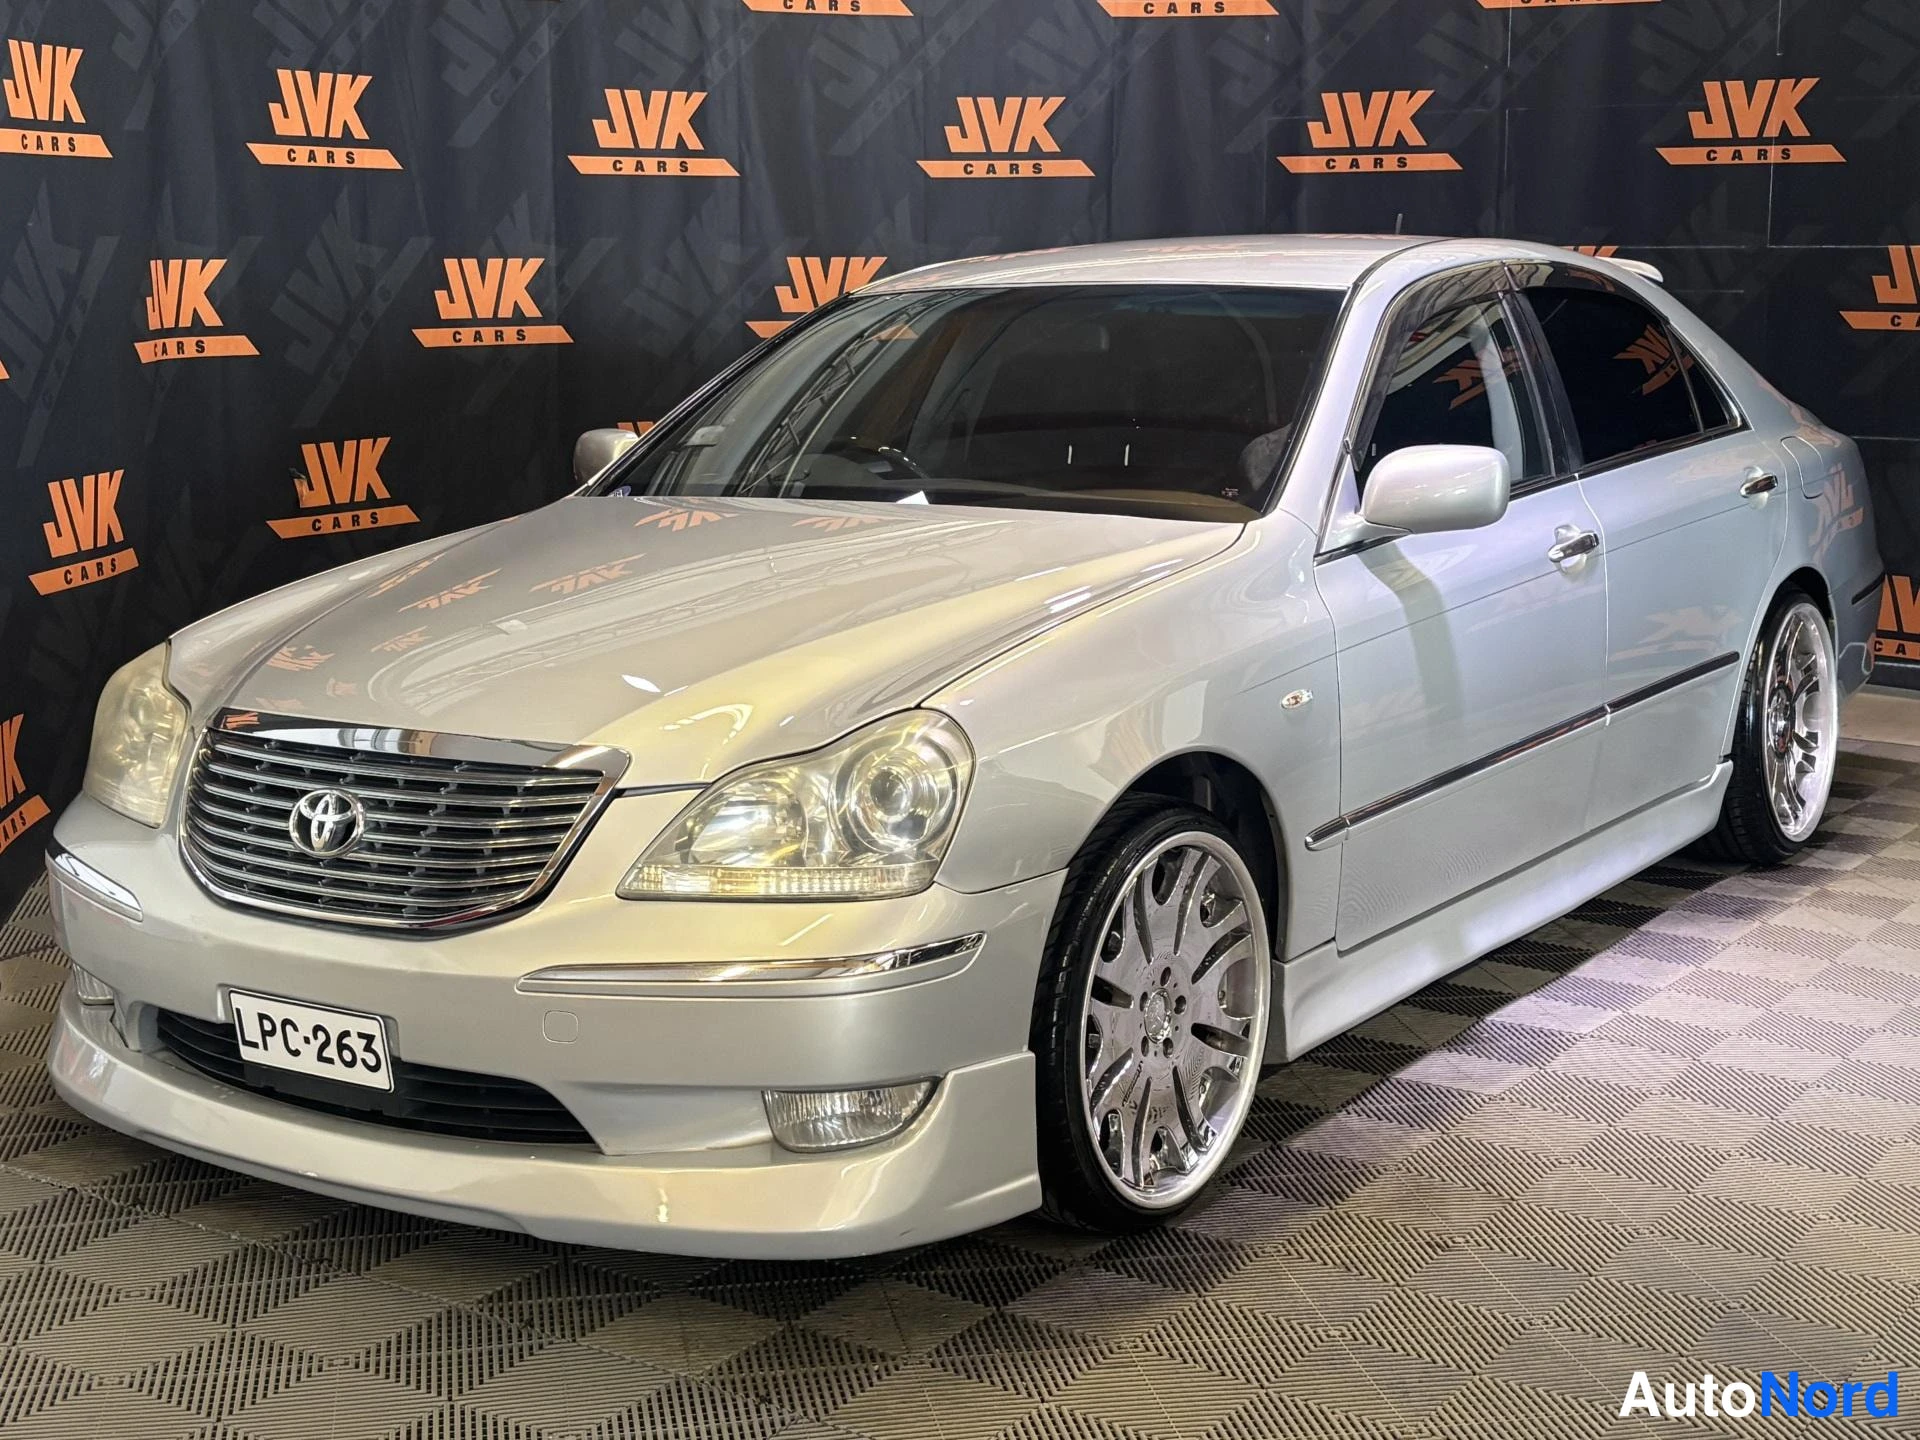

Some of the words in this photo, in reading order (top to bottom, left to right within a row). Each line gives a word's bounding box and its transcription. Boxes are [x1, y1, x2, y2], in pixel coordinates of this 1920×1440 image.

[783, 0, 861, 12] CARS
[1143, 1, 1226, 15] CARS
[3, 39, 86, 124] JVK
[268, 68, 373, 140] JVK
[592, 88, 708, 151] JVK
[1307, 89, 1435, 149] JVK
[1687, 77, 1820, 139] JVK
[943, 96, 1067, 153] JVK
[21, 133, 76, 153] CARS
[287, 148, 356, 165] CARS
[1705, 147, 1791, 162] CARS
[612, 159, 689, 173] CARS
[963, 162, 1043, 175] CARS
[1325, 156, 1408, 170] CARS
[146, 258, 228, 330] JVK
[434, 257, 545, 319] JVK
[452, 328, 527, 344] CARS
[294, 436, 391, 508] JVK
[43, 469, 125, 558] JVK
[311, 511, 380, 533] CARS
[63, 557, 117, 586] CARS
[0, 810, 27, 849] ARS
